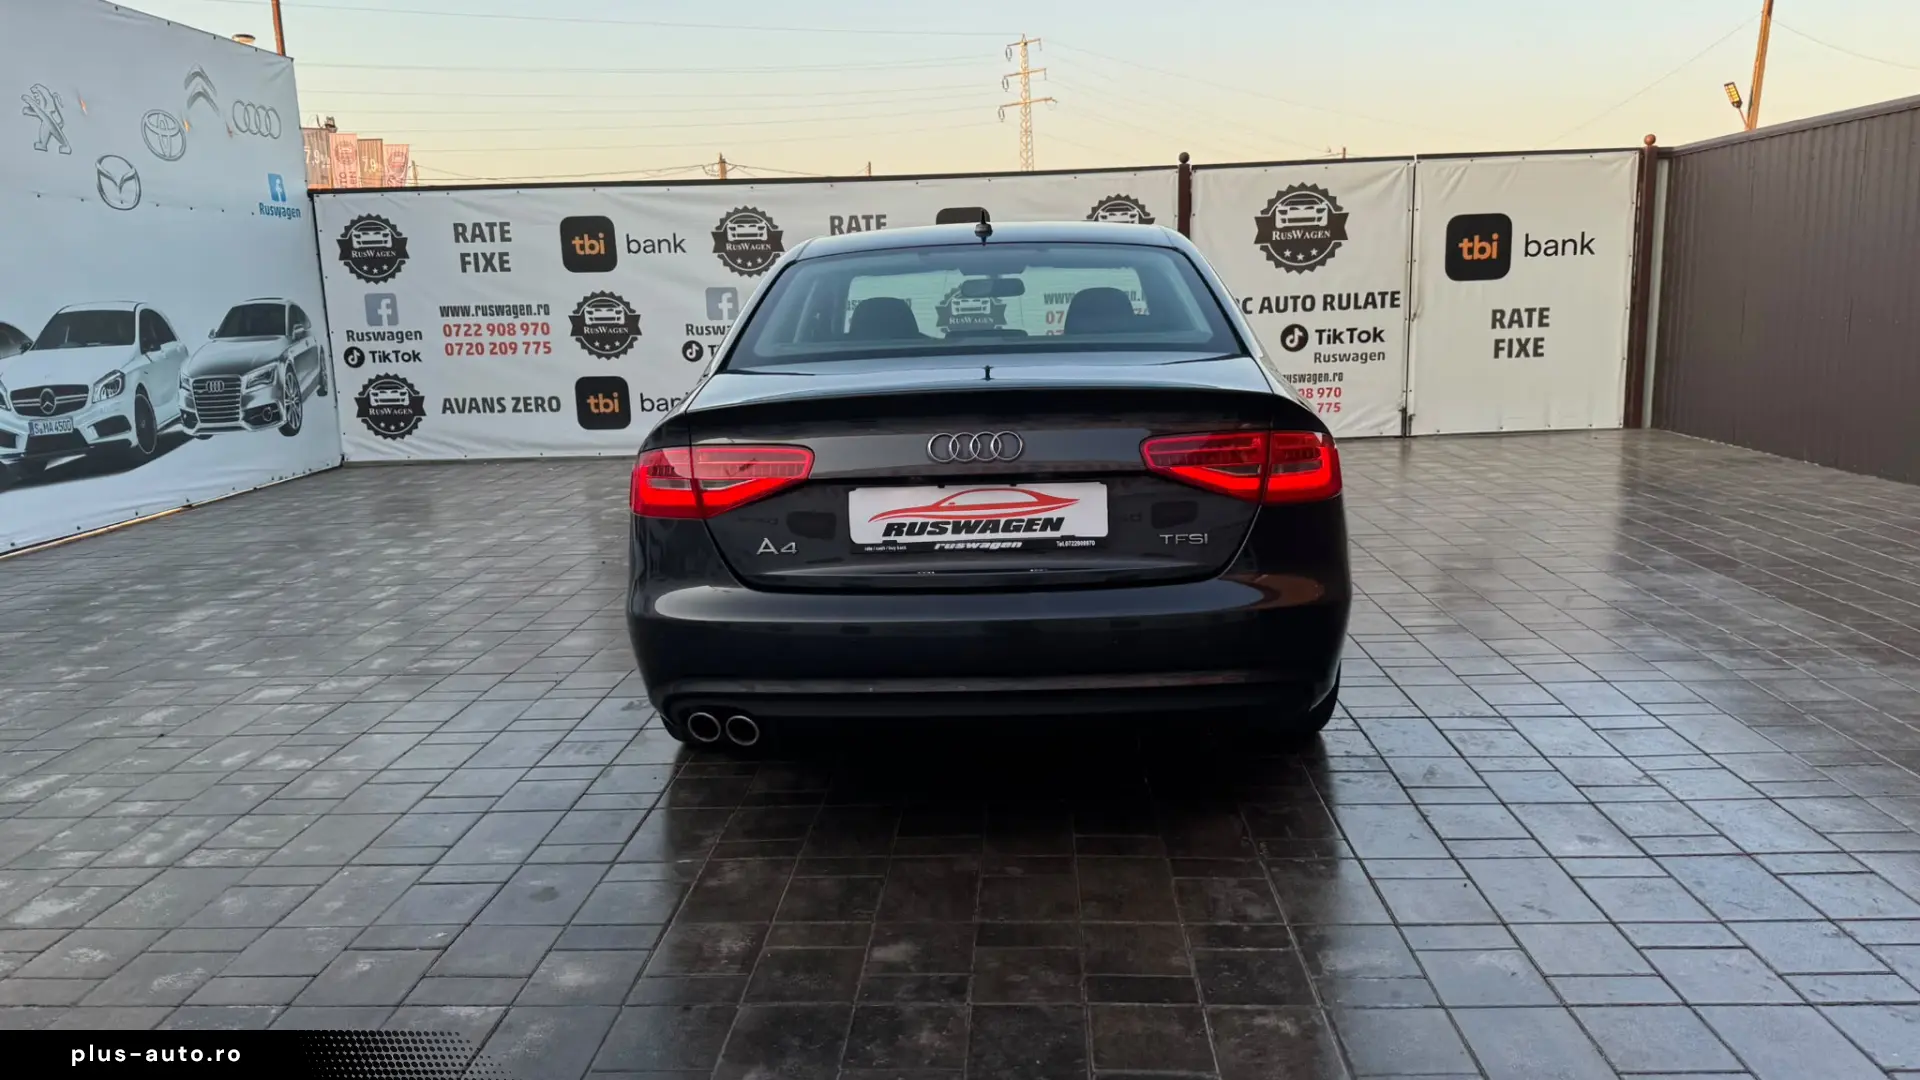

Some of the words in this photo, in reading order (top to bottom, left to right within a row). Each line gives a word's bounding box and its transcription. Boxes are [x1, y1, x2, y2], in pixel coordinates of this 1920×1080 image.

[259, 202, 301, 220] Ruswagen
[453, 222, 512, 243] RATE
[572, 232, 605, 255] tbi
[626, 232, 687, 254] bank
[1458, 233, 1499, 260] tbi
[1524, 231, 1596, 257] bank
[460, 252, 511, 273] FIXE
[439, 303, 550, 319] www.ruswagen.ro
[1258, 294, 1316, 314] AUTO
[1323, 291, 1401, 311] RULATE
[1491, 307, 1550, 329] RATE
[346, 329, 423, 344] Ruswagen
[443, 323, 483, 337] 0722
[486, 322, 517, 337] 908
[520, 322, 551, 336] 970
[1315, 327, 1386, 346] TikTok
[369, 350, 423, 364] TikTok
[445, 342, 485, 356] 0720
[489, 341, 518, 356] 209
[522, 341, 552, 355] 775
[1493, 337, 1545, 359] FIXE
[1314, 351, 1386, 364] Ruswagen
[1317, 387, 1342, 398] 970
[441, 397, 507, 414] AVANS
[511, 395, 562, 413] ZERO
[587, 391, 620, 414] tbi
[1317, 402, 1341, 413] 775
[881, 517, 1065, 537] RUSWAGEN
[756, 537, 797, 555] A4
[934, 541, 1023, 550] ruswagen
[1159, 533, 1208, 545] TFSI
